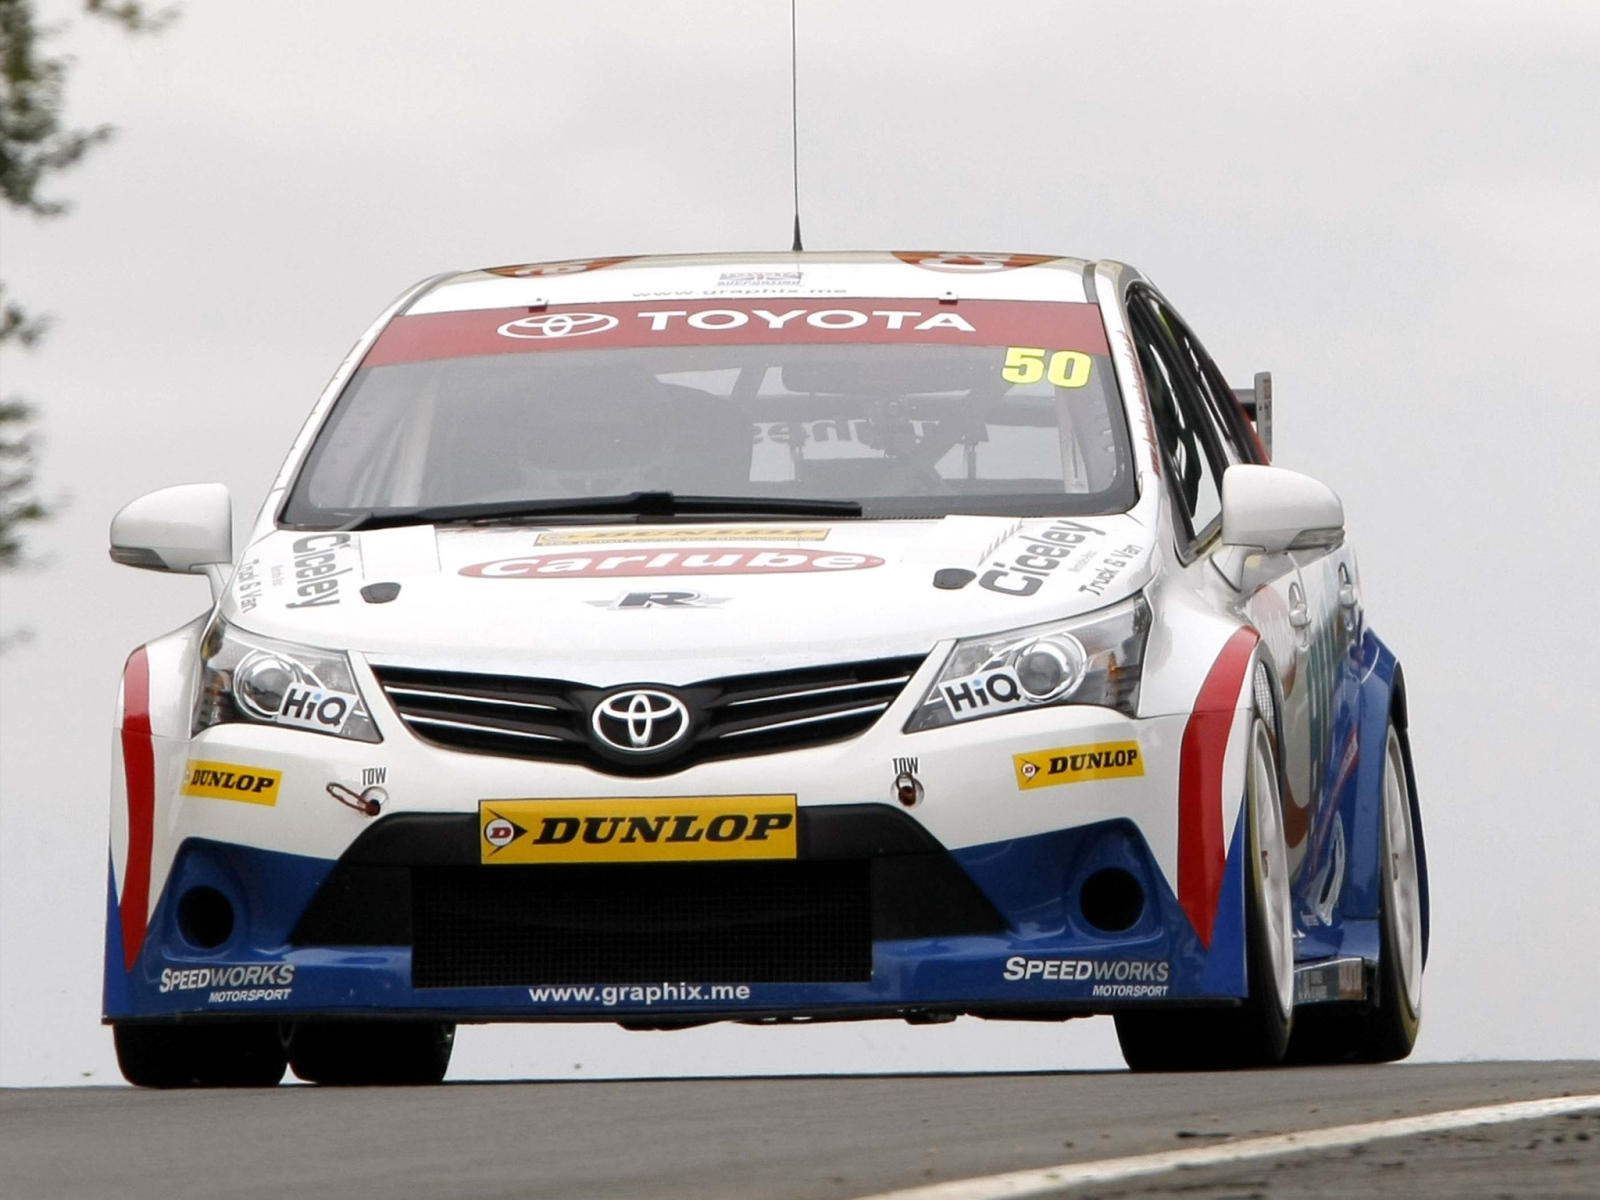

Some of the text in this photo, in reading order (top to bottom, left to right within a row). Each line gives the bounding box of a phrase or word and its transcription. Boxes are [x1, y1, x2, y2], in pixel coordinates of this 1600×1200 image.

[632, 288, 847, 297] www.graphix.me
[637, 309, 976, 332] TOYOTA
[1002, 347, 1092, 388] 50
[285, 533, 353, 609] Ciceley
[481, 551, 867, 578] carlube
[979, 520, 1107, 597] Ciceley
[1078, 567, 1120, 597] Truck
[1110, 544, 1144, 559] Van
[612, 591, 704, 608] R
[944, 673, 1021, 713] HiQ
[282, 688, 347, 728] HiQ
[892, 757, 919, 775] TOW
[1048, 750, 1137, 775] DUNLOP
[191, 769, 274, 793] DUNLOP
[362, 767, 387, 786] TOW
[532, 814, 793, 845] DUNLOP
[159, 964, 295, 993] SPEEDWORKS
[1003, 956, 1169, 982] SPEEDWORKS
[208, 988, 292, 1003] MOTORSPORT
[529, 982, 751, 1005] www.graphix.me
[1092, 985, 1169, 997] MOTORSPORT
